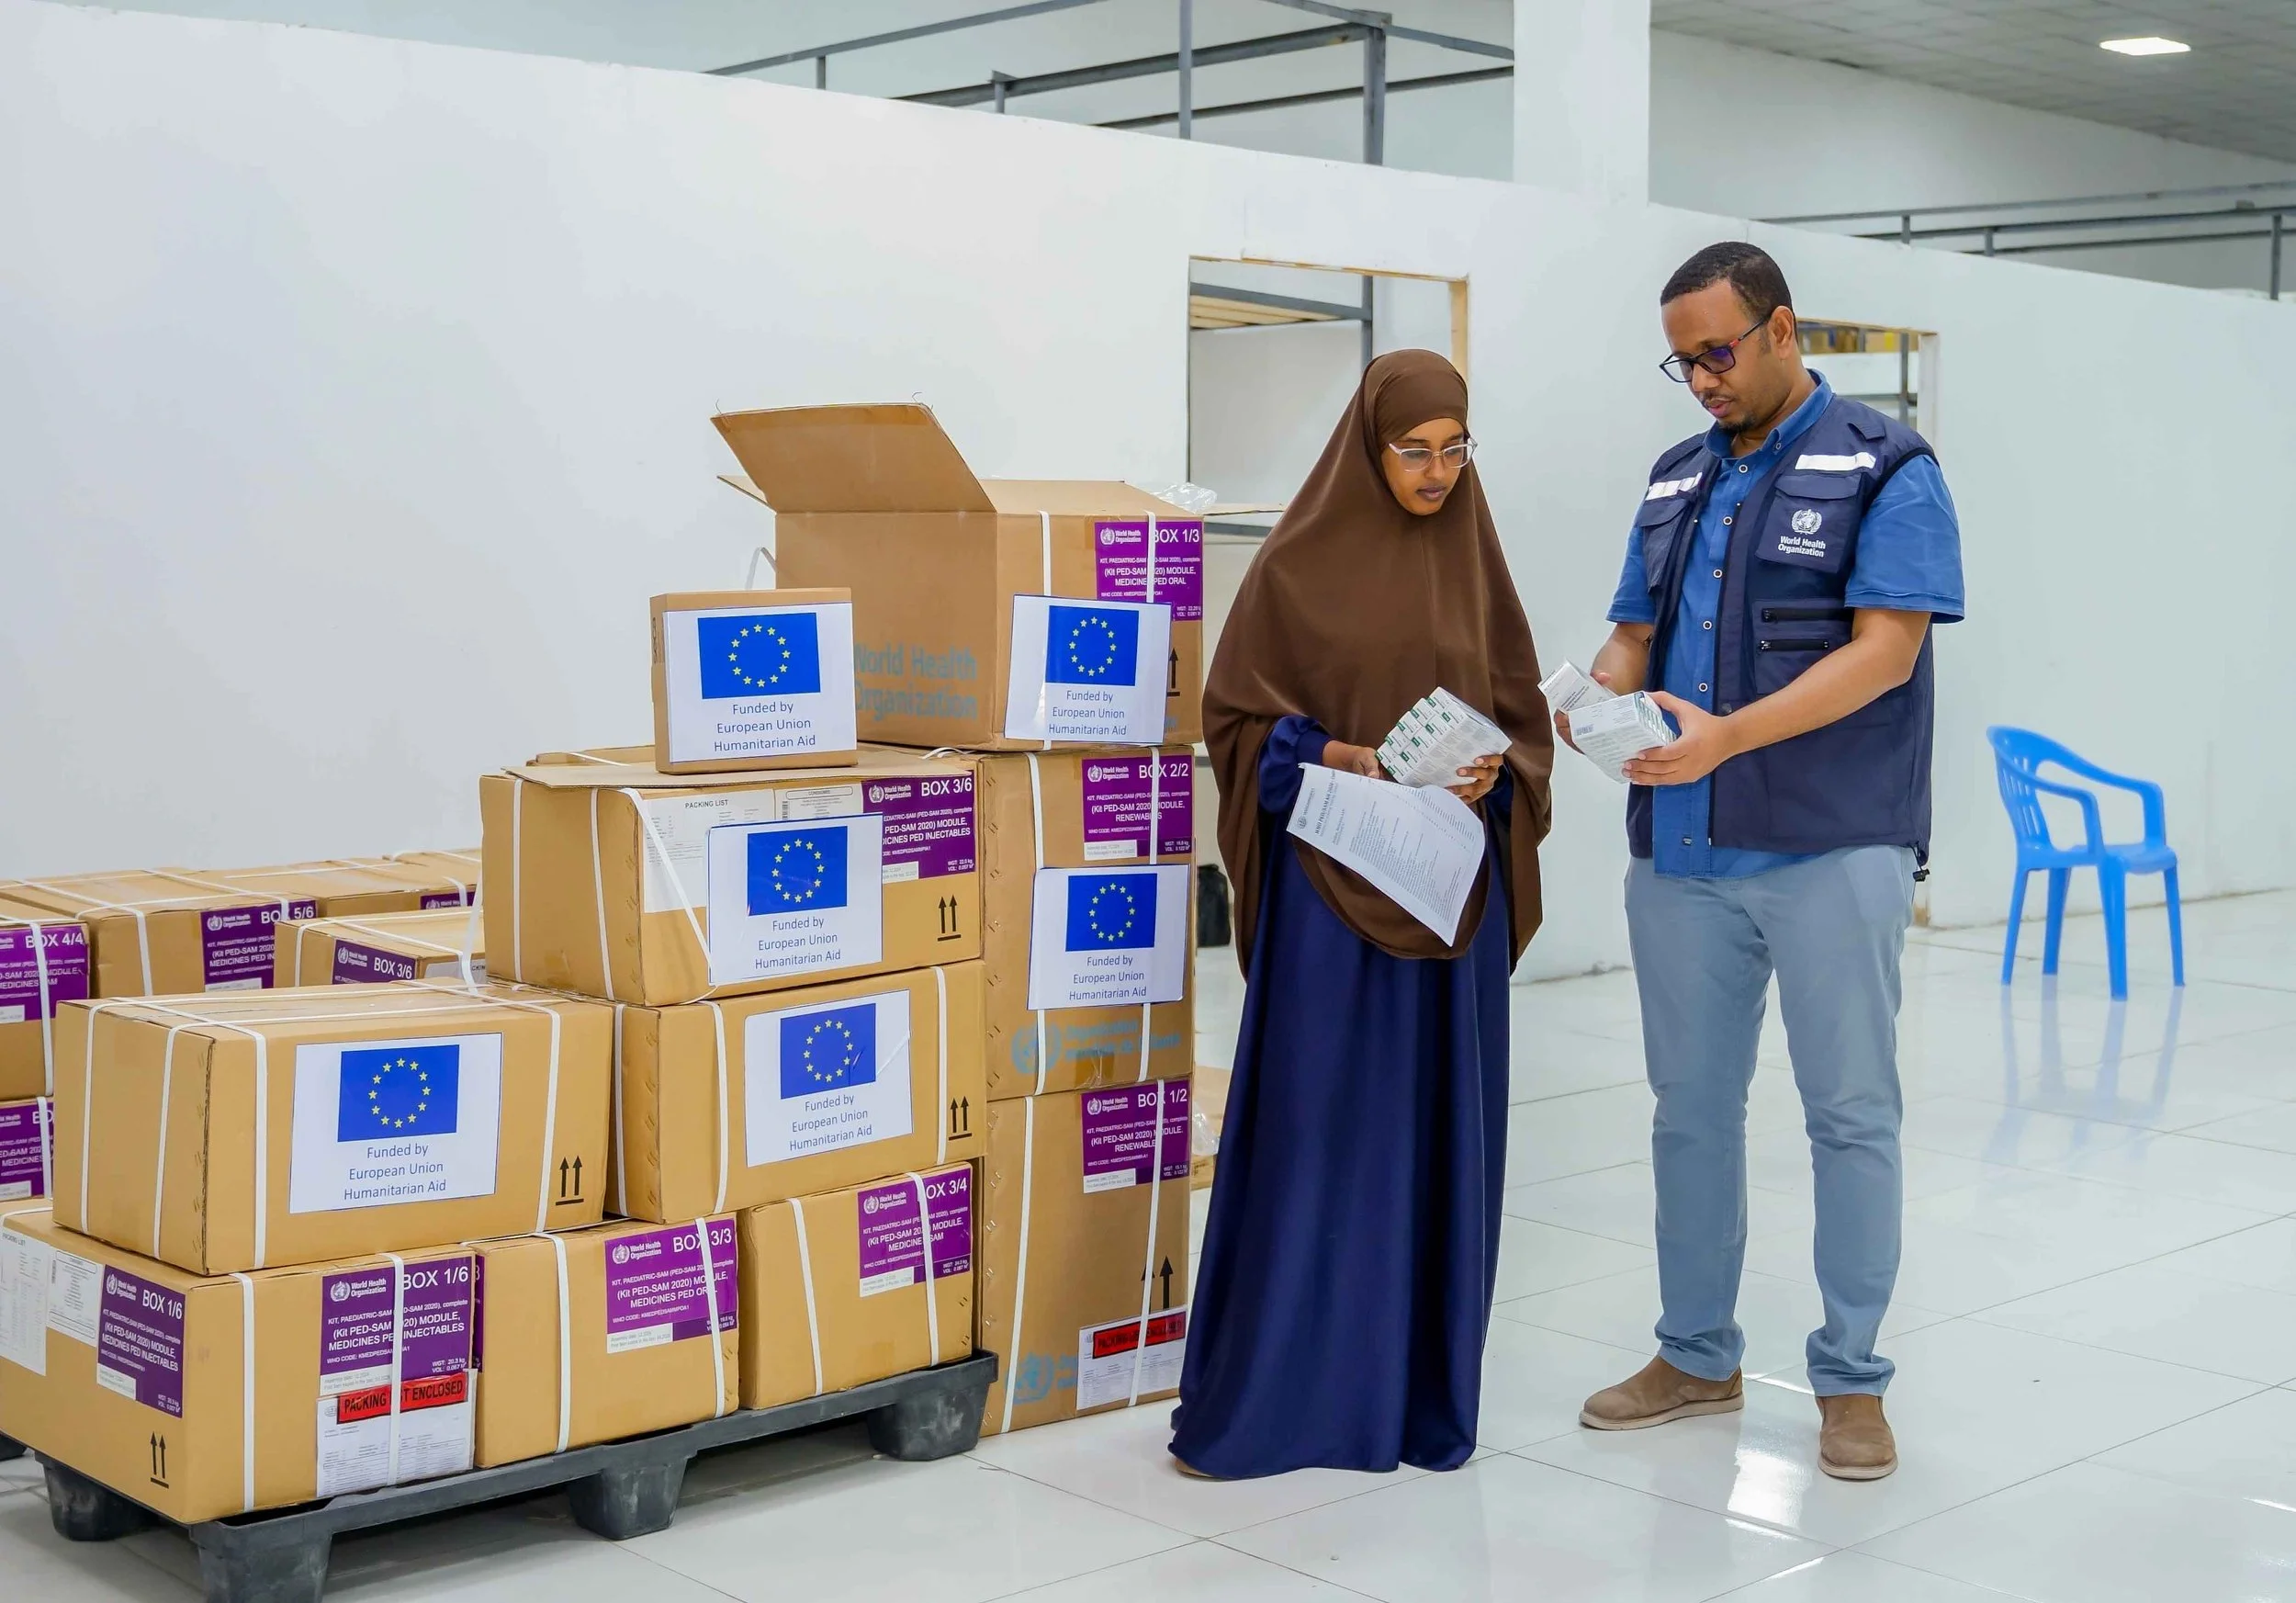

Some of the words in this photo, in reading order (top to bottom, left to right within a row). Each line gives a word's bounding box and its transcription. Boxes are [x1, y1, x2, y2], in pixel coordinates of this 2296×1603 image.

[1182, 529, 1200, 543] 1/3
[1780, 536, 1800, 546] World
[1802, 538, 1826, 549] Health
[1778, 544, 1824, 558] Organization
[1166, 567, 1197, 576] MODULE,
[1154, 577, 1167, 586] PED
[1168, 577, 1187, 585] ORAL
[910, 645, 977, 680] Health
[1066, 691, 1101, 702] Funded
[1103, 691, 1113, 705] by
[733, 702, 777, 715] Funded
[780, 701, 793, 715] by
[1052, 707, 1096, 719] European
[1098, 709, 1124, 718] Union
[716, 720, 773, 735] European
[777, 717, 811, 730] Union
[1049, 724, 1109, 735] Humanitarian
[1111, 726, 1127, 735] Aid
[714, 738, 793, 752] Humanitarian
[797, 735, 816, 748] Aid
[1170, 762, 1188, 777] 2/2
[1103, 773, 1130, 781] Organization
[921, 780, 950, 796] BOX
[953, 777, 972, 794] 3/6
[884, 792, 911, 800] Organization
[1091, 805, 1102, 814] (Kit
[1104, 803, 1135, 812] PED-SAM
[885, 823, 917, 834] PED-SAM
[917, 820, 937, 831] 2020)
[937, 818, 968, 829] MODULE,
[909, 832, 924, 842] PED
[926, 828, 970, 841] INJECTABLES
[261, 910, 281, 924] BO
[294, 906, 314, 919] 5/6
[772, 919, 810, 931] Funded
[812, 917, 825, 931] by
[62, 933, 84, 946] 4/4
[759, 934, 806, 952] European
[809, 931, 838, 944] Union
[224, 946, 257, 956] PED-SAM
[209, 956, 250, 967] MEDICINES
[252, 954, 266, 963] PED
[755, 952, 823, 970] Humanitarian
[825, 949, 841, 963] Aid
[1087, 955, 1120, 966] Funded
[1122, 955, 1133, 967] by
[374, 957, 395, 976] BOX
[397, 965, 412, 979] 3/6
[1073, 974, 1115, 985] European
[1119, 972, 1144, 982] Union
[1069, 988, 1130, 1001] Humanitarian
[1131, 987, 1147, 998] Aid
[1170, 1089, 1187, 1103] 1/2
[805, 1095, 841, 1112] Funded
[843, 1095, 854, 1106] by
[1102, 1103, 1128, 1112] Organization
[792, 1115, 838, 1134] European
[841, 1109, 869, 1123] Union
[790, 1128, 854, 1151] Humanitarian
[857, 1124, 872, 1135] Aid
[1091, 1137, 1102, 1146] (Kit
[1103, 1134, 1134, 1145] PED-SAM
[1135, 1131, 1153, 1141] 2020)
[367, 1145, 411, 1158] Funded
[415, 1144, 428, 1157] by
[349, 1167, 405, 1180] European
[410, 1162, 444, 1175] Union
[344, 1183, 424, 1200] Humanitarian
[427, 1180, 446, 1191] Aid
[925, 1181, 946, 1200] OX
[950, 1178, 967, 1195] 3/4
[880, 1195, 893, 1203] World
[893, 1191, 906, 1200] Health
[880, 1199, 906, 1210] Organization
[872, 1219, 911, 1233] PAEDIATRIC-SAM
[950, 1207, 968, 1215] complete
[711, 1227, 732, 1246] 3/3
[867, 1237, 880, 1247] (Kit
[880, 1229, 912, 1244] PED-SAM
[933, 1217, 963, 1231] MODULE,
[630, 1244, 645, 1252] World
[646, 1241, 661, 1249] Health
[630, 1249, 661, 1260] Organization
[445, 1266, 468, 1284] 1/6
[623, 1270, 669, 1284] PAEDIATRIC-SAM
[670, 1266, 696, 1277] (PED-SAM
[713, 1259, 733, 1268] complete
[351, 1281, 367, 1290] World
[368, 1278, 386, 1286] Health
[617, 1290, 630, 1301] (Kit
[632, 1282, 669, 1296] PED-SAM
[670, 1279, 692, 1290] 2020)
[118, 1288, 136, 1301] Organization
[351, 1286, 386, 1297] Organization
[142, 1290, 165, 1314] BOX
[167, 1301, 182, 1319] 1/6
[630, 1292, 676, 1308] MEDICINES
[678, 1290, 694, 1299] PED
[340, 1310, 392, 1323] PAEDIATRIC-SAM
[424, 1303, 441, 1311] 2020),
[443, 1299, 468, 1308] complete
[625, 1314, 640, 1322] CODE:
[333, 1326, 349, 1339] (Kit
[349, 1321, 391, 1336] PED-SAM
[419, 1312, 461, 1325] MODULE,
[114, 1325, 138, 1342] PED-SAM
[138, 1335, 151, 1350] 2020)
[151, 1340, 176, 1359] MODULE,
[329, 1336, 380, 1350] MEDICINES
[404, 1323, 465, 1339] INJECTABLES
[102, 1334, 130, 1352] MEDICINES
[130, 1345, 141, 1358] PED
[141, 1349, 178, 1372] INJECTABLES
[341, 1354, 356, 1362] CODE:
[344, 1393, 387, 1413] PACKING
[413, 1381, 463, 1401] ENCLOSED
